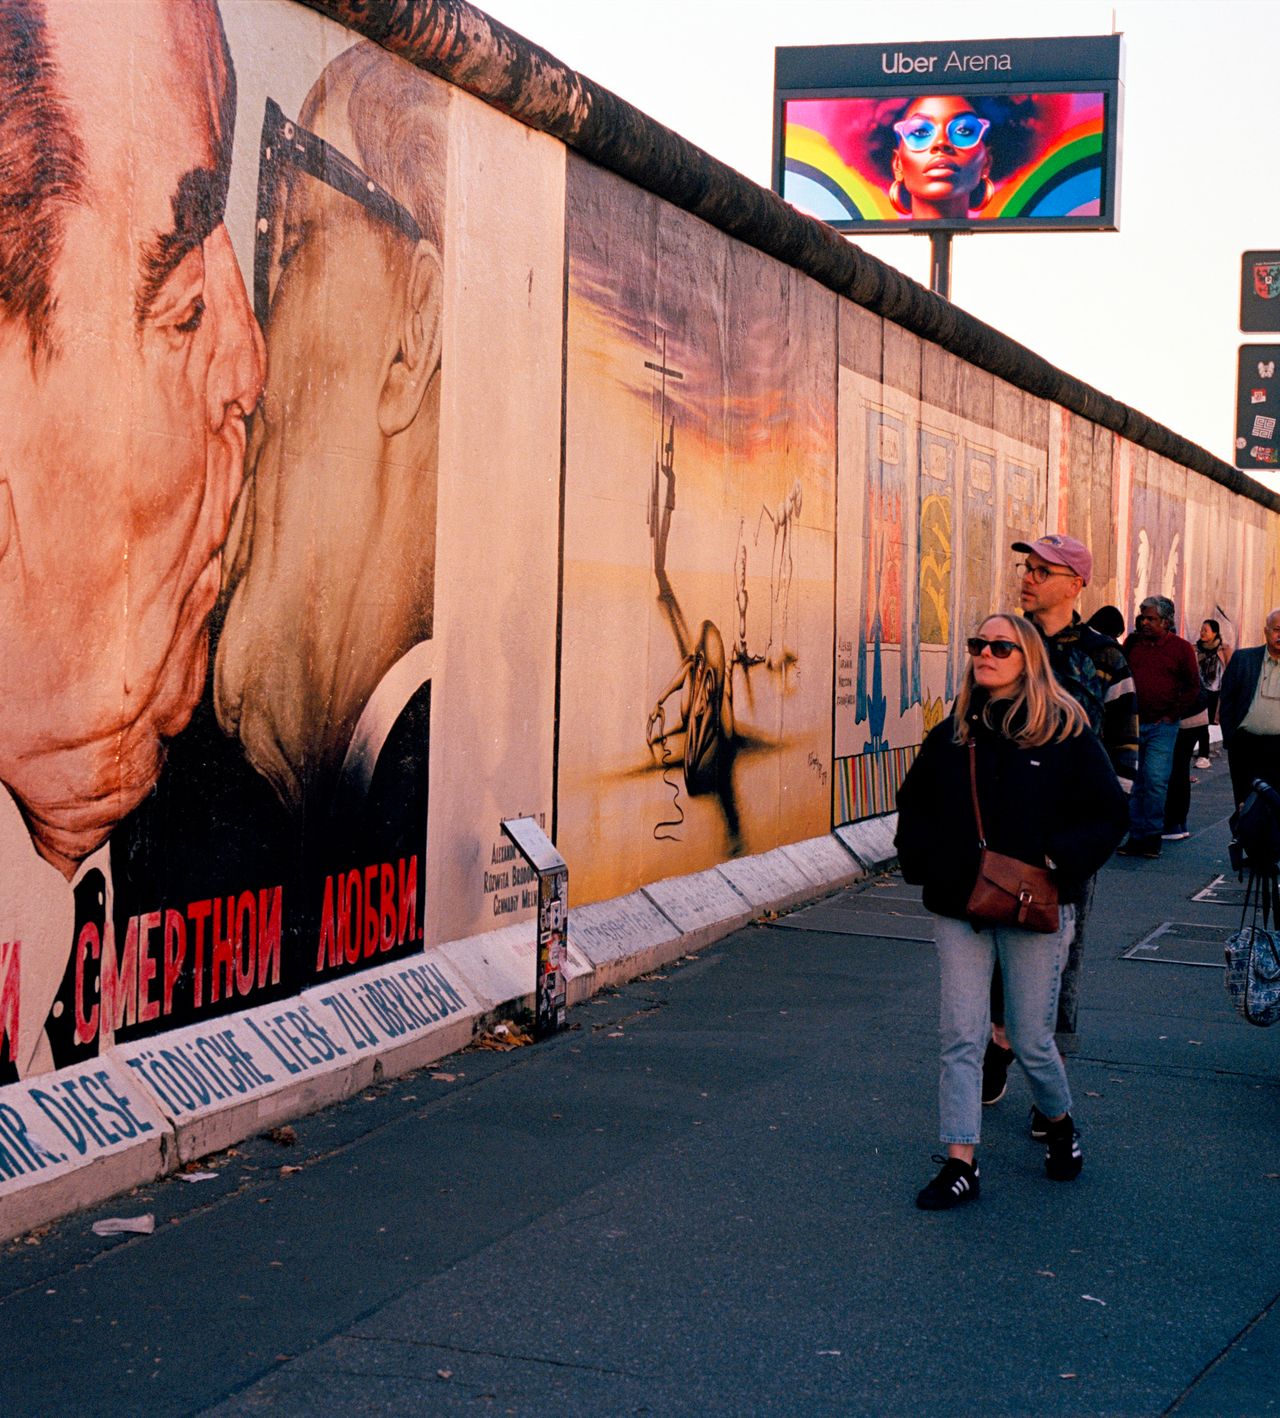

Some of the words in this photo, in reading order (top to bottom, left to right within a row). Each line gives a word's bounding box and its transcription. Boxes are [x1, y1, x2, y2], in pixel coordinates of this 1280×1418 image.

[882, 52, 938, 74] Uber
[944, 51, 1012, 71] Arena
[74, 885, 283, 1046] СМЕРТНОЙ
[316, 854, 424, 973] ЛЮБВИ.
[320, 992, 378, 1050] ZU
